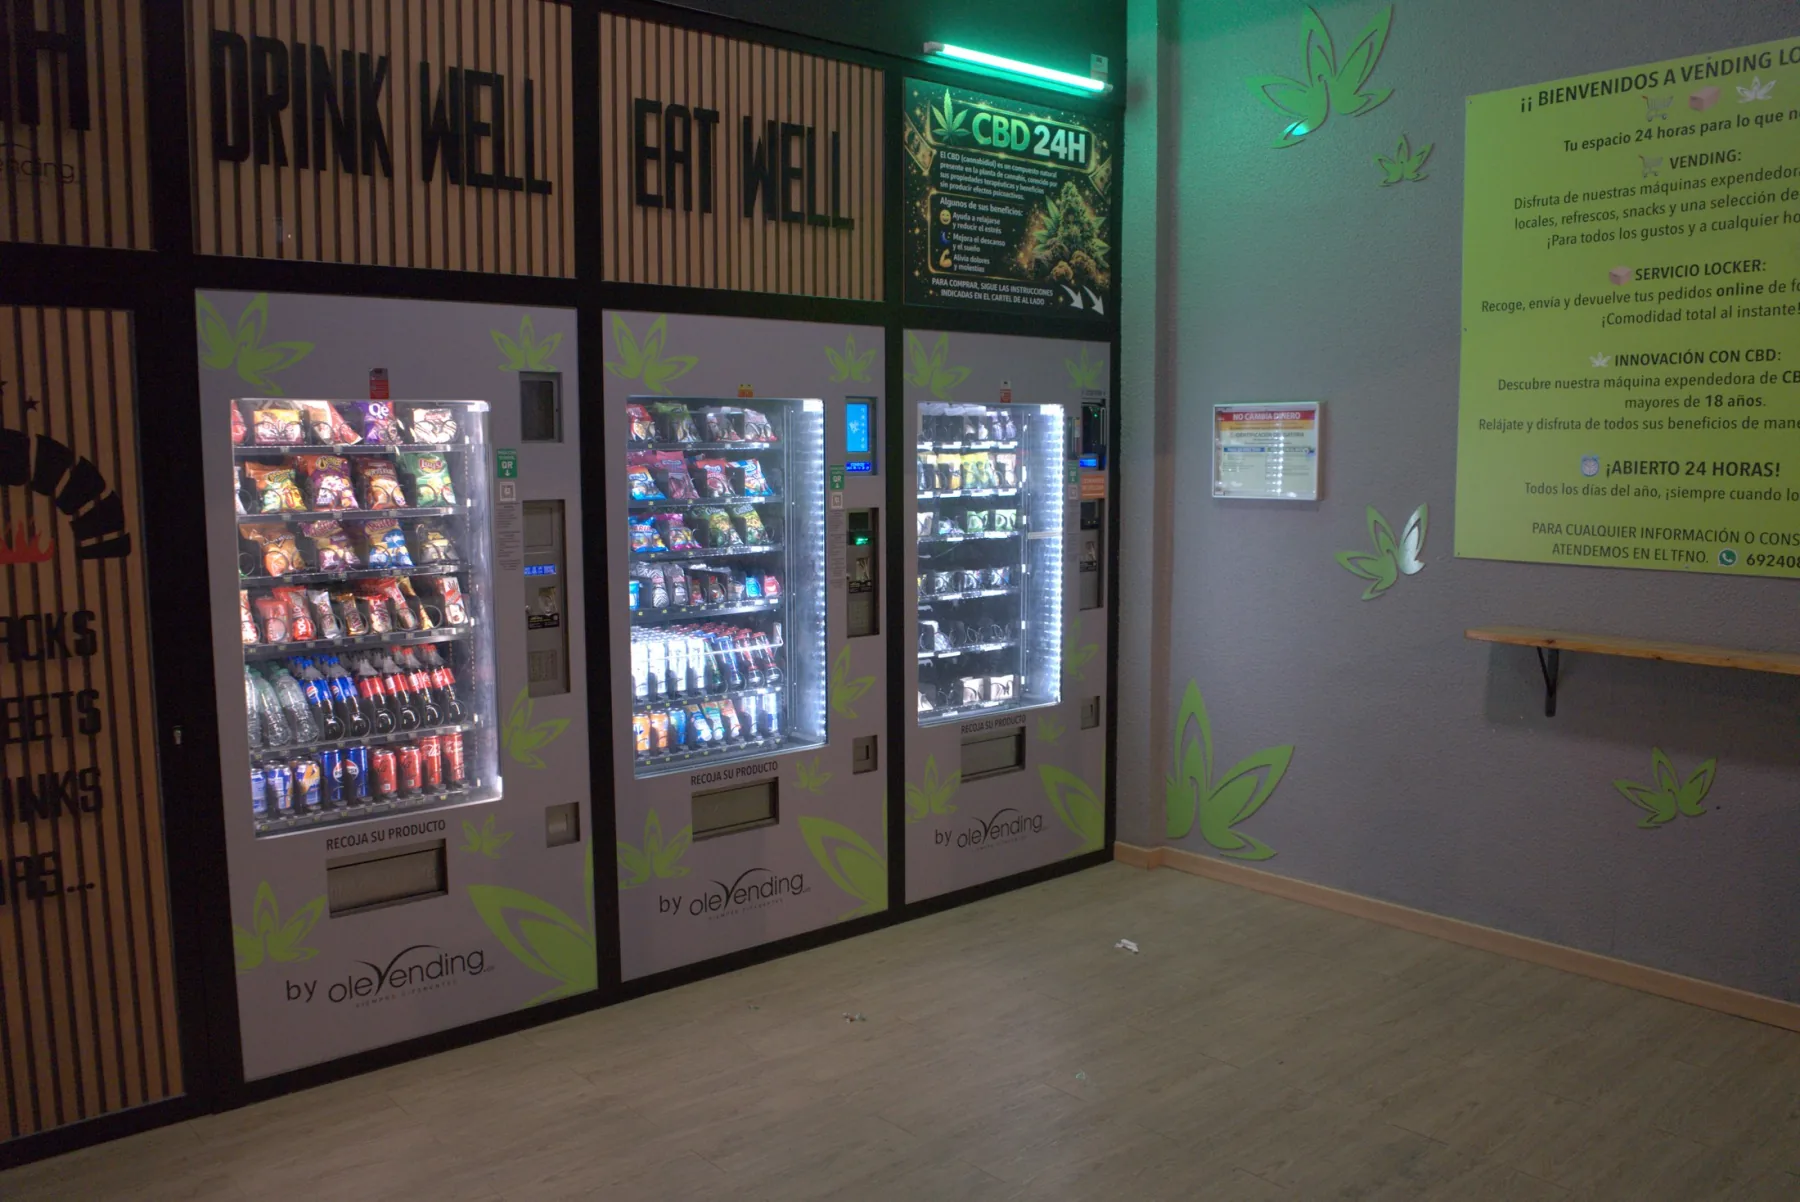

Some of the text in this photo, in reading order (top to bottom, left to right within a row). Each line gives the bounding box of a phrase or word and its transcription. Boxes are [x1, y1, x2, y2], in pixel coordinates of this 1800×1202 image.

[1538, 71, 1658, 107] BIENVENIDOS
[1663, 69, 1676, 86] A
[1680, 51, 1773, 84] VENDING
[212, 29, 553, 195] DRINK WELL
[972, 112, 1086, 163] CBD 24H
[1563, 111, 1784, 152] Tu espacio 24 horas para lo que
[634, 97, 854, 230] EAT WELL
[947, 153, 960, 161] CBD
[1670, 149, 1742, 170] VENDING:
[1514, 165, 1800, 210] Disfruta de nuestras máquinas expendedor
[940, 196, 968, 208] Algunos
[968, 201, 977, 210] de
[1514, 187, 1800, 230] locales, refrescos, snacks y una selección de
[1547, 233, 1578, 250] ¡Para
[1580, 228, 1615, 244] todos
[1619, 224, 1637, 240] los
[1640, 222, 1684, 243] gustos
[1688, 222, 1696, 237] y
[1699, 220, 1707, 232] a
[1711, 211, 1779, 232] cualquier
[1635, 259, 1767, 281] SERVICIO LOCKER:
[931, 278, 948, 287] PARA
[1481, 298, 1526, 314] Recoge,
[1529, 296, 1561, 311] envía
[1563, 296, 1571, 310] y
[1573, 291, 1631, 307] devuelve
[1635, 290, 1654, 303] tus
[1658, 285, 1713, 305] pedidos
[1716, 281, 1764, 298] online
[1768, 279, 1787, 294] de
[1602, 301, 1800, 328] ¡Comodidad total al instante!
[1615, 348, 1782, 367] INNOVACIÓN CON CBD:
[1498, 377, 1551, 391] Descubre
[1554, 376, 1600, 389] nuestra
[1603, 374, 1661, 391] máquina
[1664, 371, 1756, 390] expendedora
[1759, 371, 1778, 384] de
[1624, 393, 1767, 412] mayores de 18 años.
[1233, 413, 1243, 421] NO
[1244, 412, 1272, 421] CAMBIA
[1479, 417, 1523, 434] Relájate
[1526, 420, 1533, 434] y
[1536, 417, 1581, 431] disfruta
[1584, 417, 1600, 431] de
[1604, 417, 1639, 431] todos
[1642, 419, 1664, 431] sus
[1668, 416, 1738, 431] beneficios
[1741, 416, 1760, 431] de
[501, 461, 513, 469] QR
[1606, 460, 1781, 478] ¡ABIERTO 24 HORAS!
[1525, 482, 1800, 503] Todos los días del año, ¡siempre cuando lo
[1532, 522, 1563, 536] PARA
[1565, 523, 1637, 539] CUALQUIER
[1640, 526, 1740, 544] INFORMACIÓN
[1744, 531, 1755, 544] O
[1552, 543, 1629, 559] ATENDEMOS
[1633, 547, 1650, 561] EN
[1654, 549, 1668, 562] EL
[1671, 549, 1709, 564] TFNO.
[961, 714, 1026, 734] RECOJA SU PRODUCTO
[691, 760, 778, 786] RECOJA SU PRODUCTO
[326, 819, 446, 851] RECOJA SU PRODUCTO
[935, 829, 952, 846] by
[659, 895, 682, 915] by
[286, 978, 318, 1004] by
